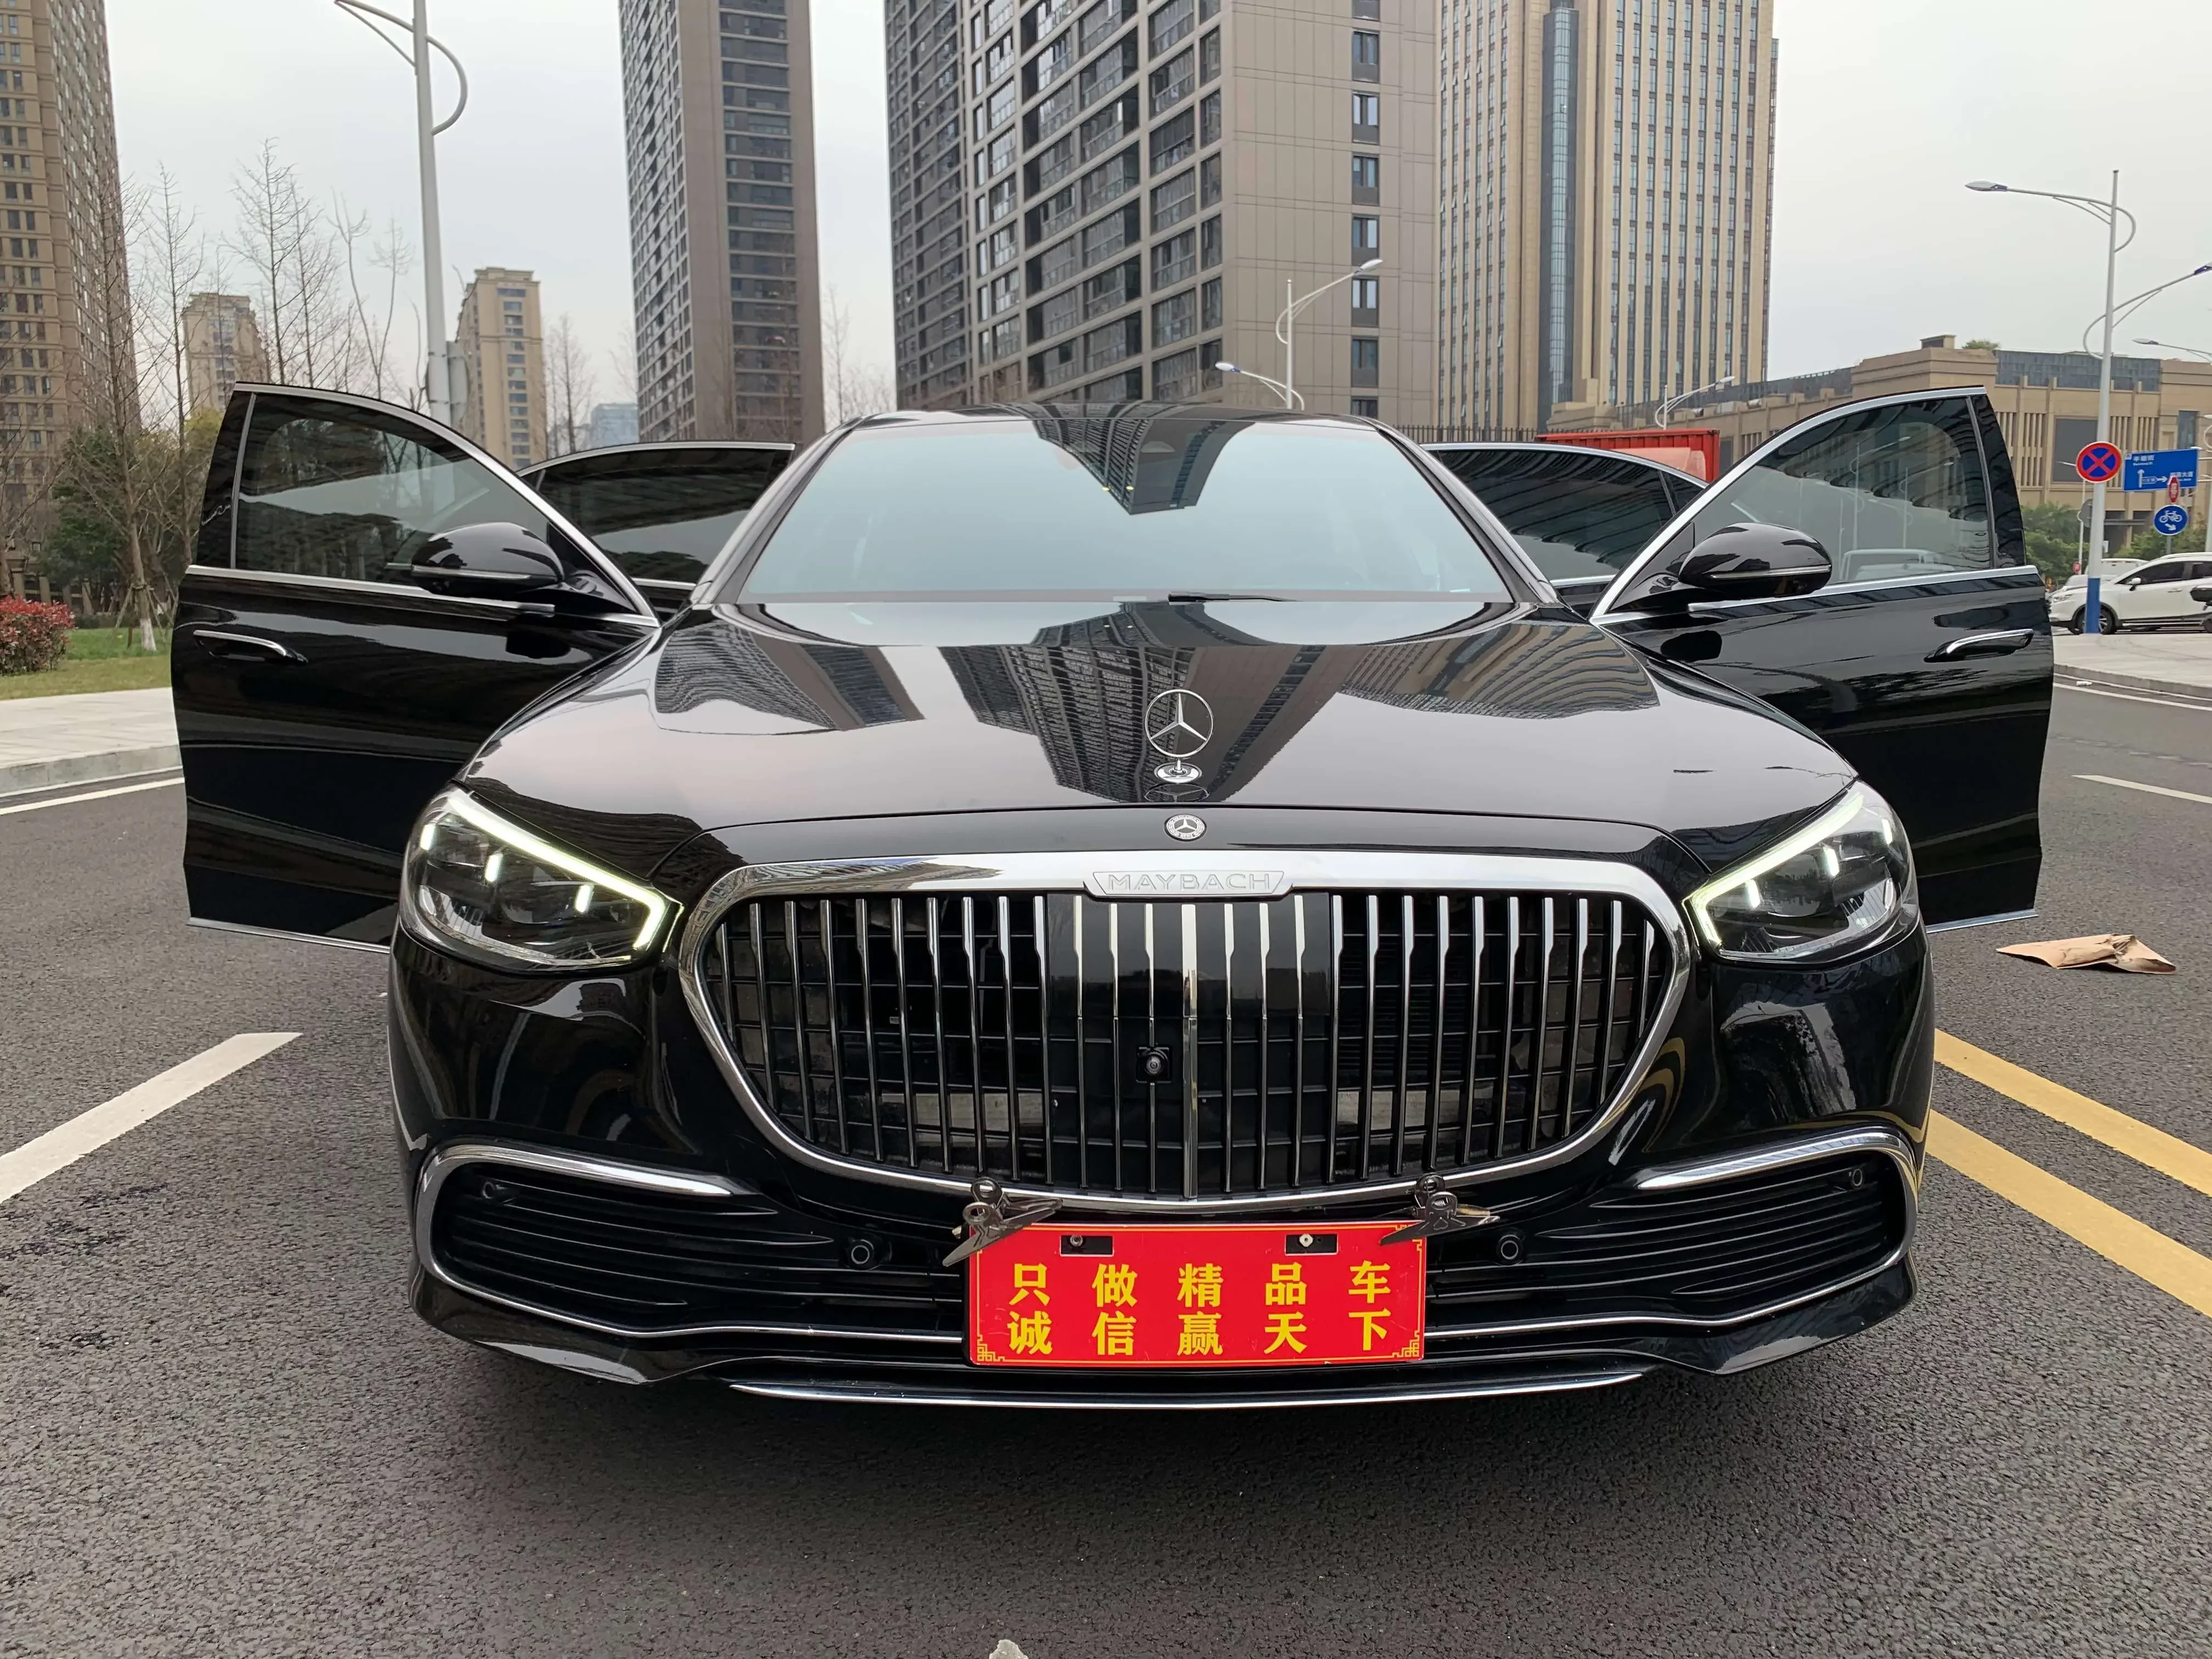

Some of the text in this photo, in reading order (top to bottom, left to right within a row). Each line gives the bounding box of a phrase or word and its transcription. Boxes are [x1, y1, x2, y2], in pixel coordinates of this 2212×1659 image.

[1108, 874, 1270, 890] MAYBACH
[1008, 1261, 1391, 1307] 只做精品车
[1007, 1309, 1392, 1356] 诚信赢天下
